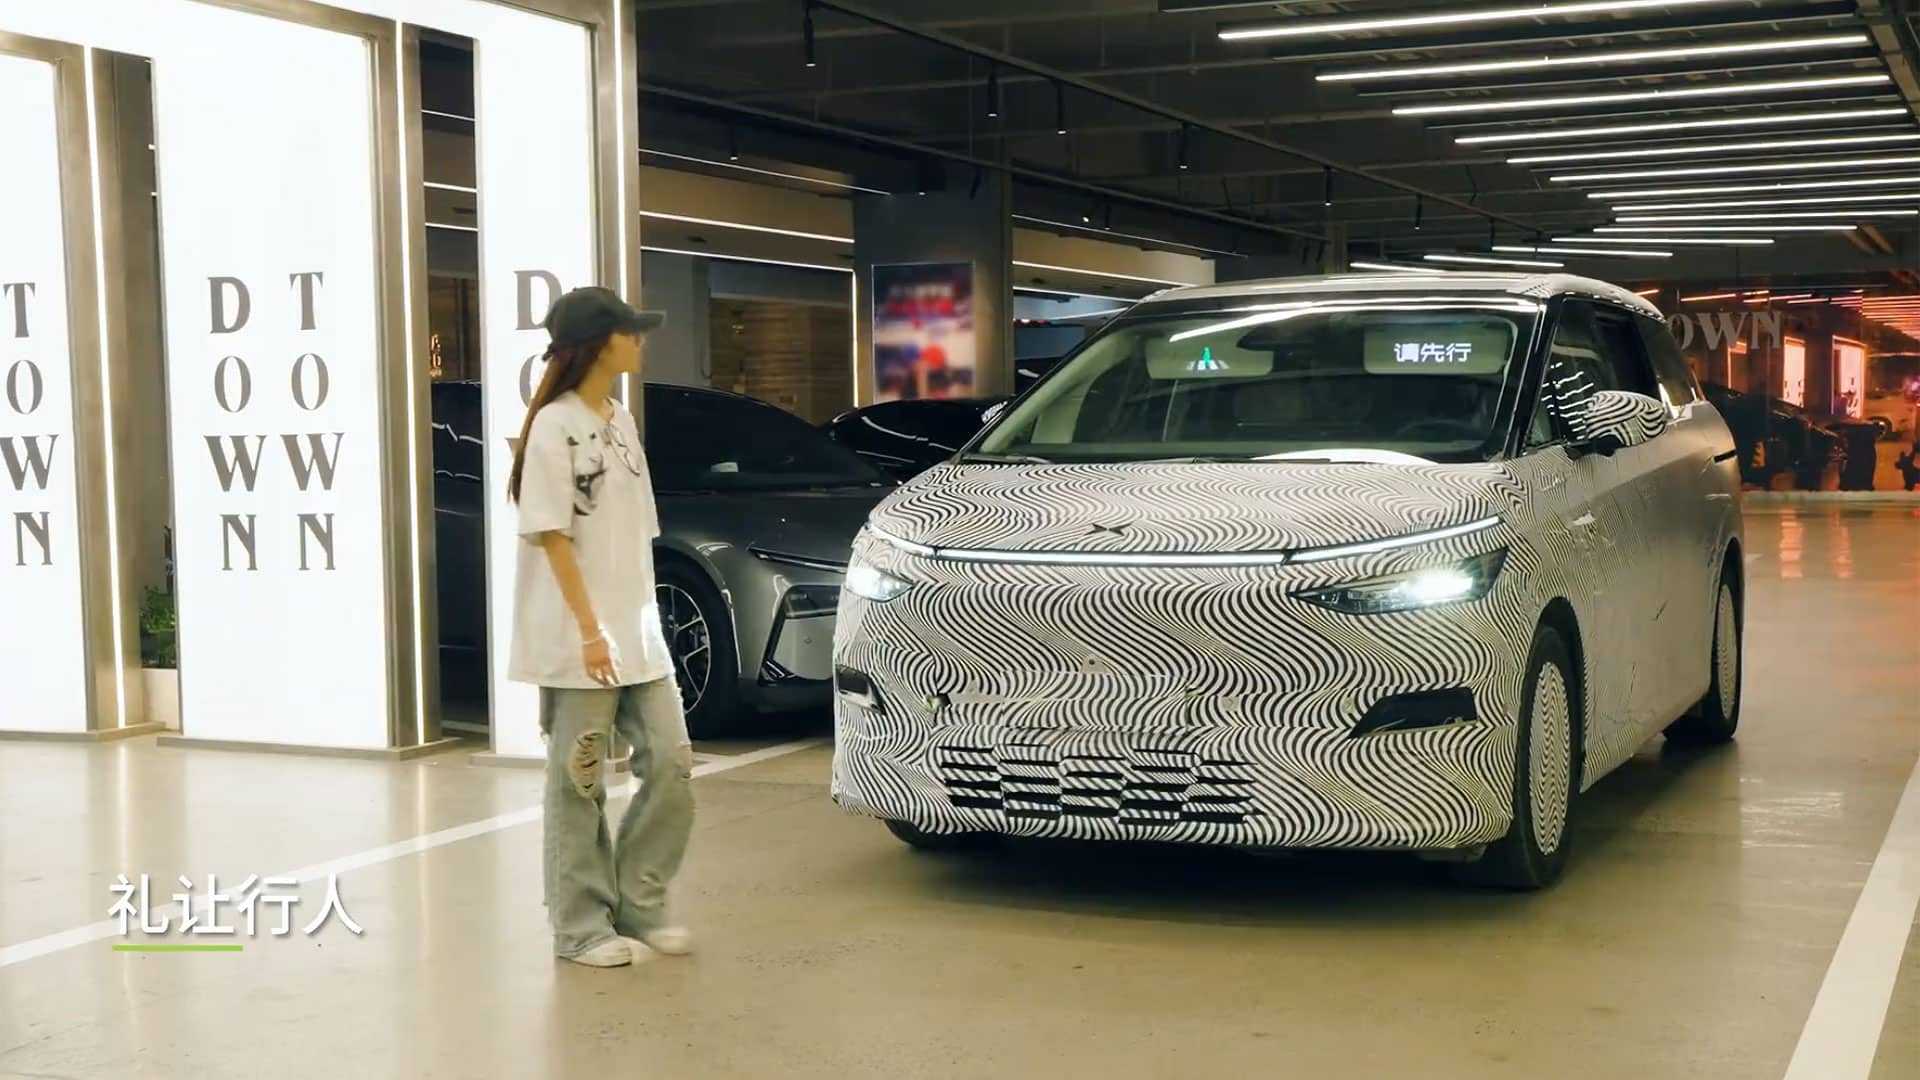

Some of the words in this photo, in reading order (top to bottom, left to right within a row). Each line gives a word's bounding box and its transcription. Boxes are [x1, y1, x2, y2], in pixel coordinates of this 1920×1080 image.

[0, 282, 59, 566] TOWN
[204, 276, 267, 571] DOWN
[280, 271, 345, 571] TOWN
